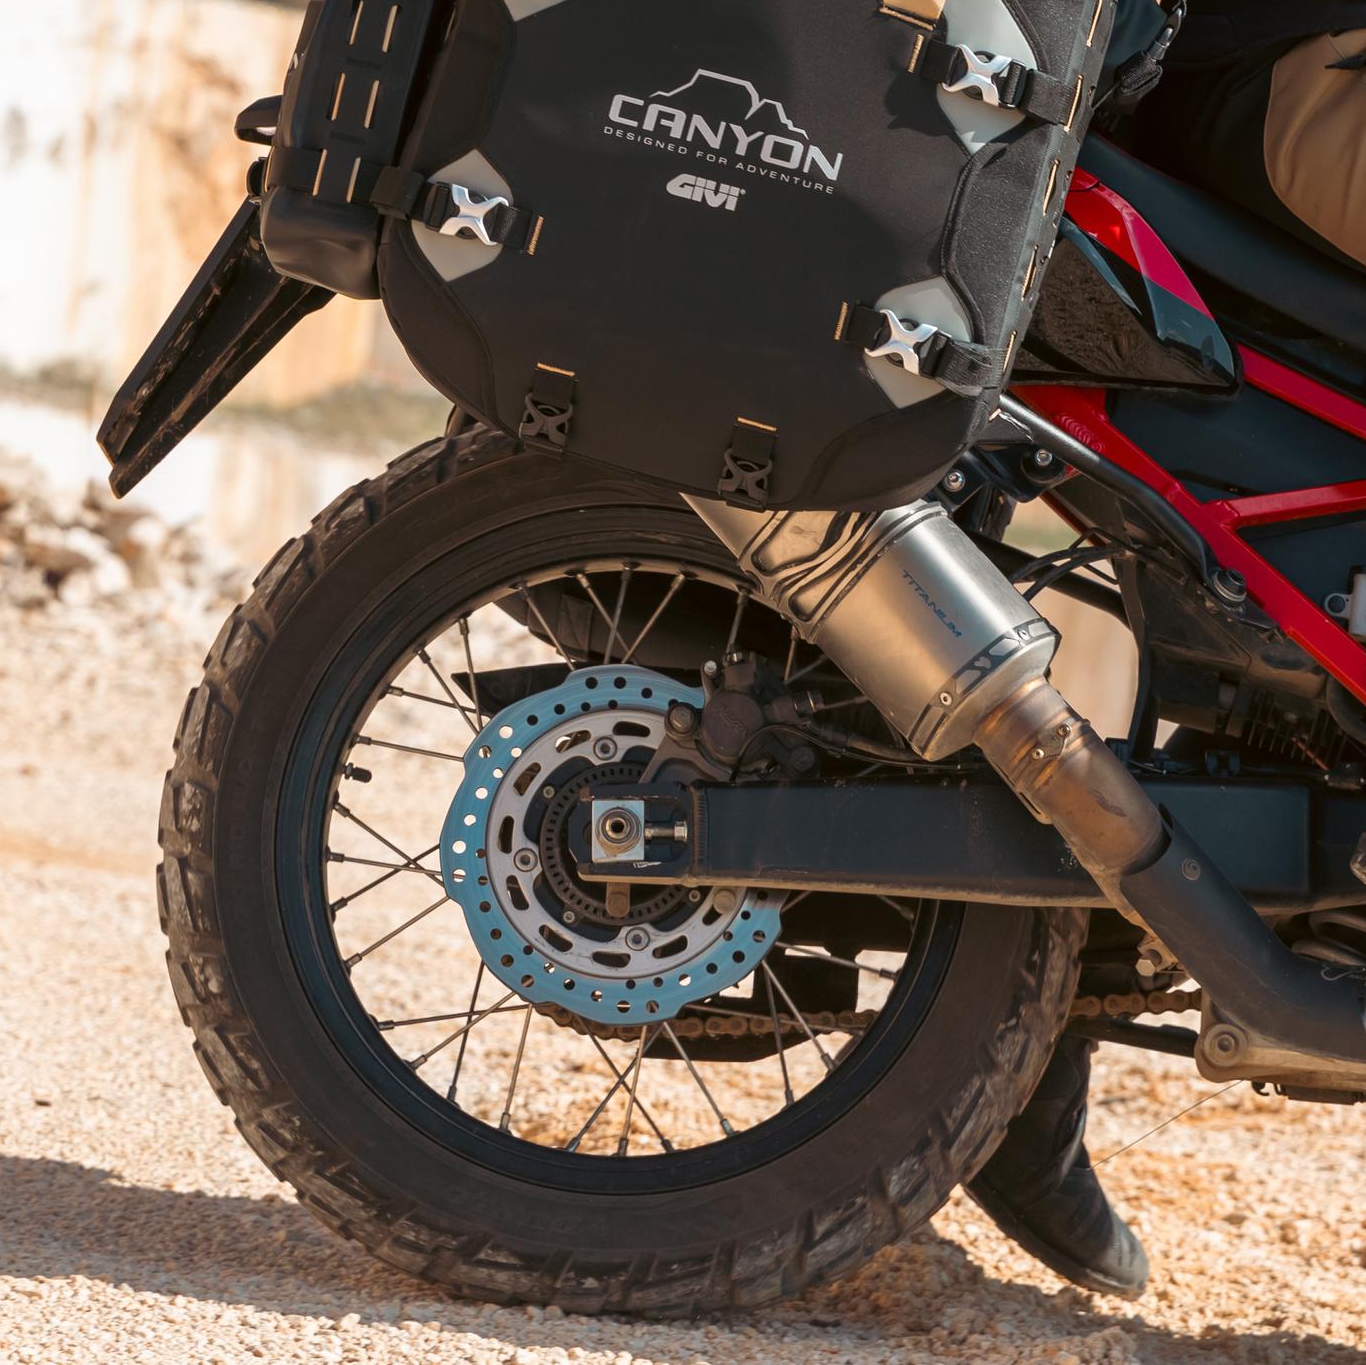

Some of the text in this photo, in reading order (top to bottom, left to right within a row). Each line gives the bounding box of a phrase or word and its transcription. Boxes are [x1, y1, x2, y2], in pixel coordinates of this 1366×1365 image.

[603, 126, 836, 195] DESIGNED FOR ADVENTURE
[608, 94, 844, 181] CANYON
[666, 173, 743, 212] GIVI
[902, 569, 963, 638] TITANIUM
